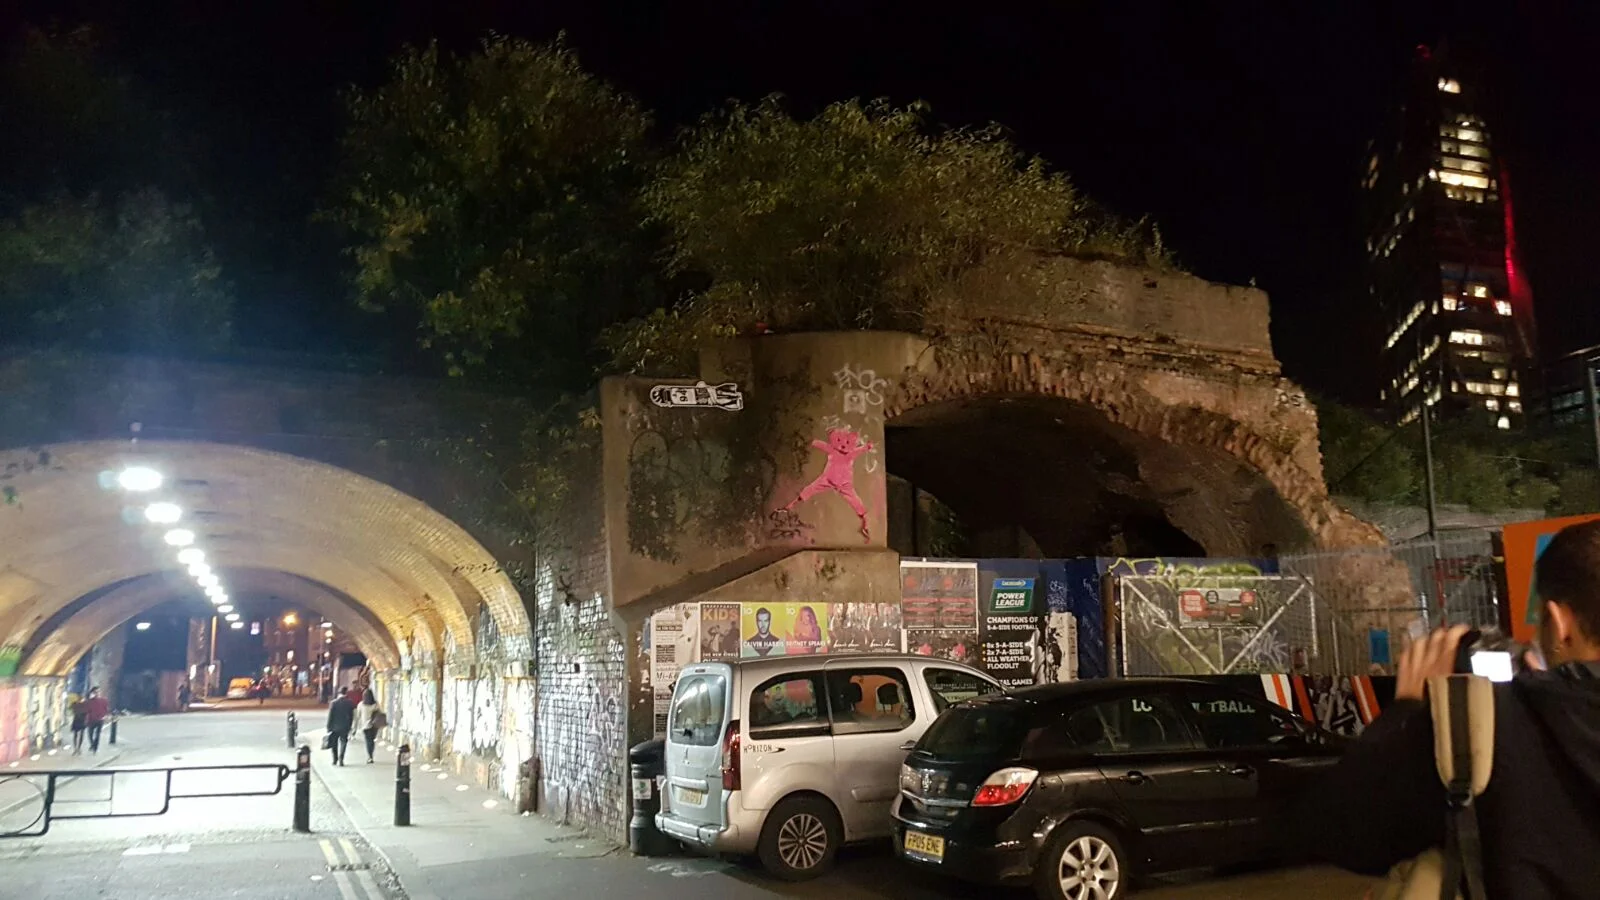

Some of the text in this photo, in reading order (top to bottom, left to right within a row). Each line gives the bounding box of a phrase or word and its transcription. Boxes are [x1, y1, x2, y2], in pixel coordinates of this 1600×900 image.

[996, 592, 1025, 600] POWER
[994, 599, 1025, 607] LEAGUE
[703, 608, 738, 621] KIDS
[986, 616, 1028, 624] CHAMPIONS
[743, 744, 773, 753] HORIZON
